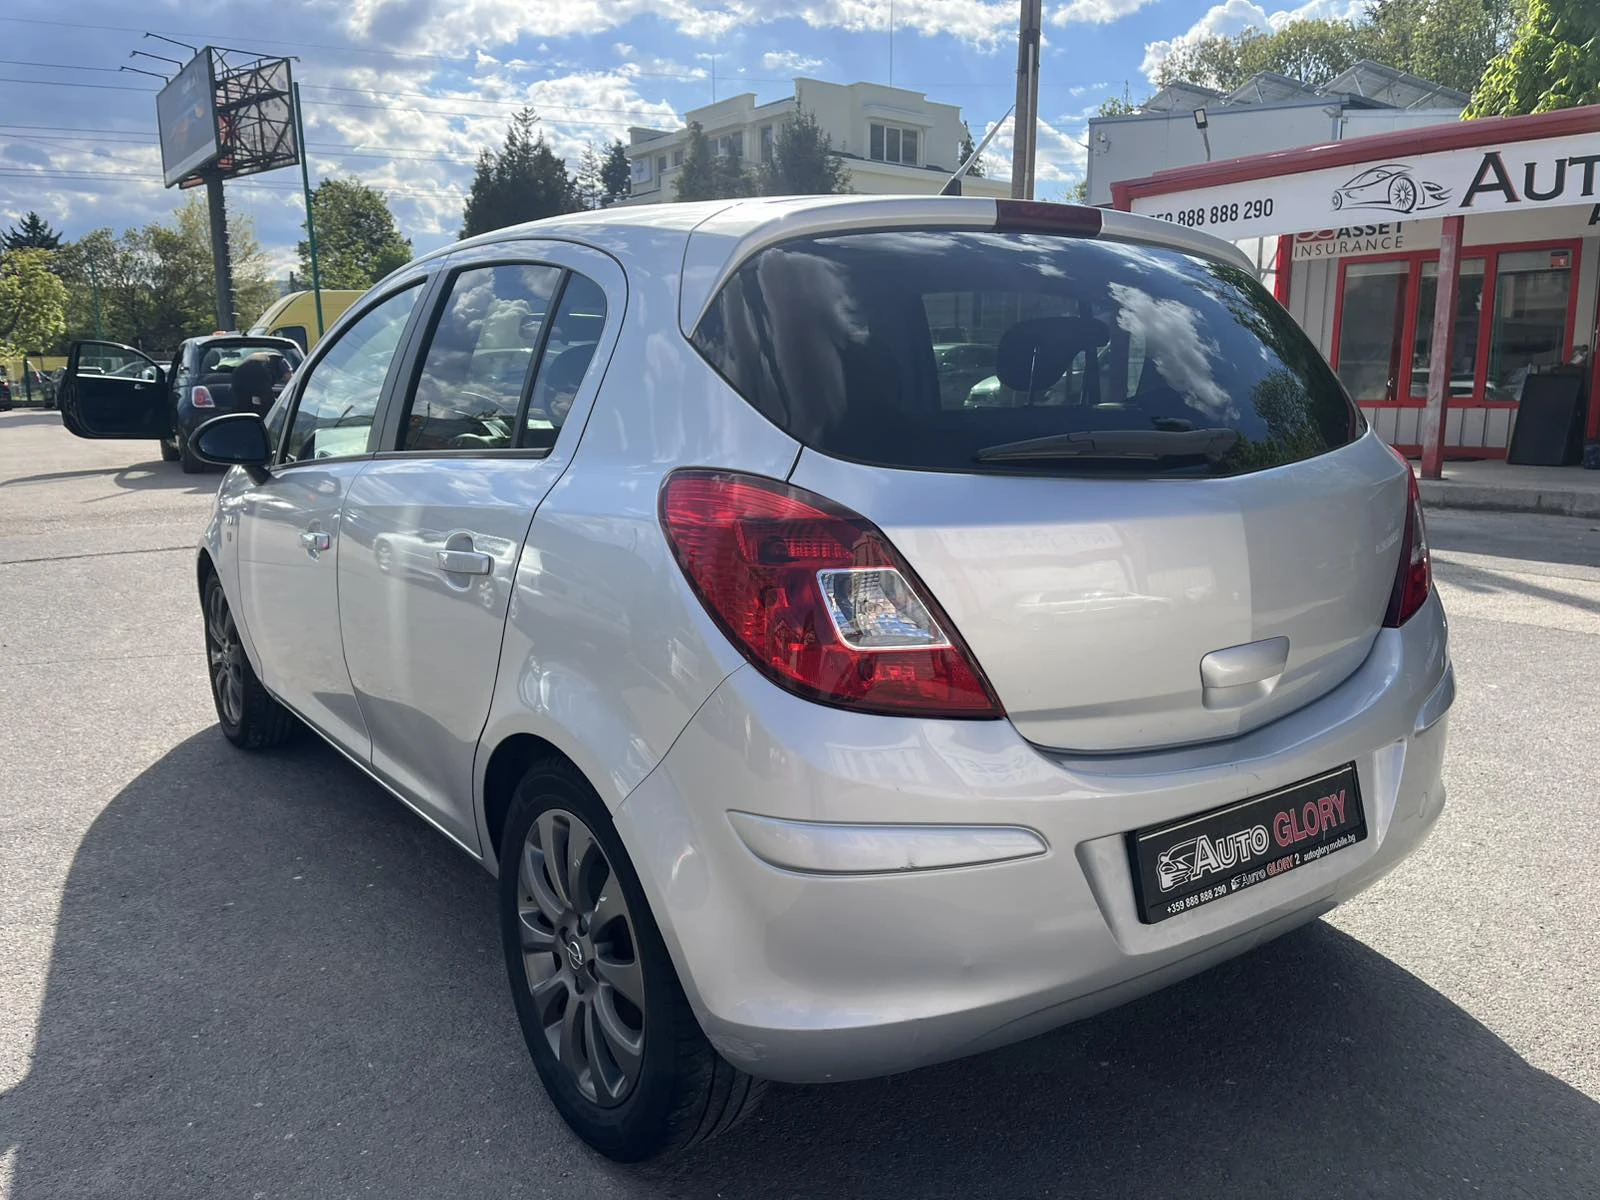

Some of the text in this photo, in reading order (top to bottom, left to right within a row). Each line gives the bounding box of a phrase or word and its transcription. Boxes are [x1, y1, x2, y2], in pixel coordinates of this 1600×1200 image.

[1178, 208, 1205, 227] 888
[1210, 203, 1239, 225] 888
[1243, 198, 1273, 220] 290
[1294, 236, 1404, 257] INSURANCE
[1190, 789, 1346, 881] AUTO GLORY
[1267, 854, 1294, 876] GLORY
[1167, 884, 1227, 913] +359 888 888 290
